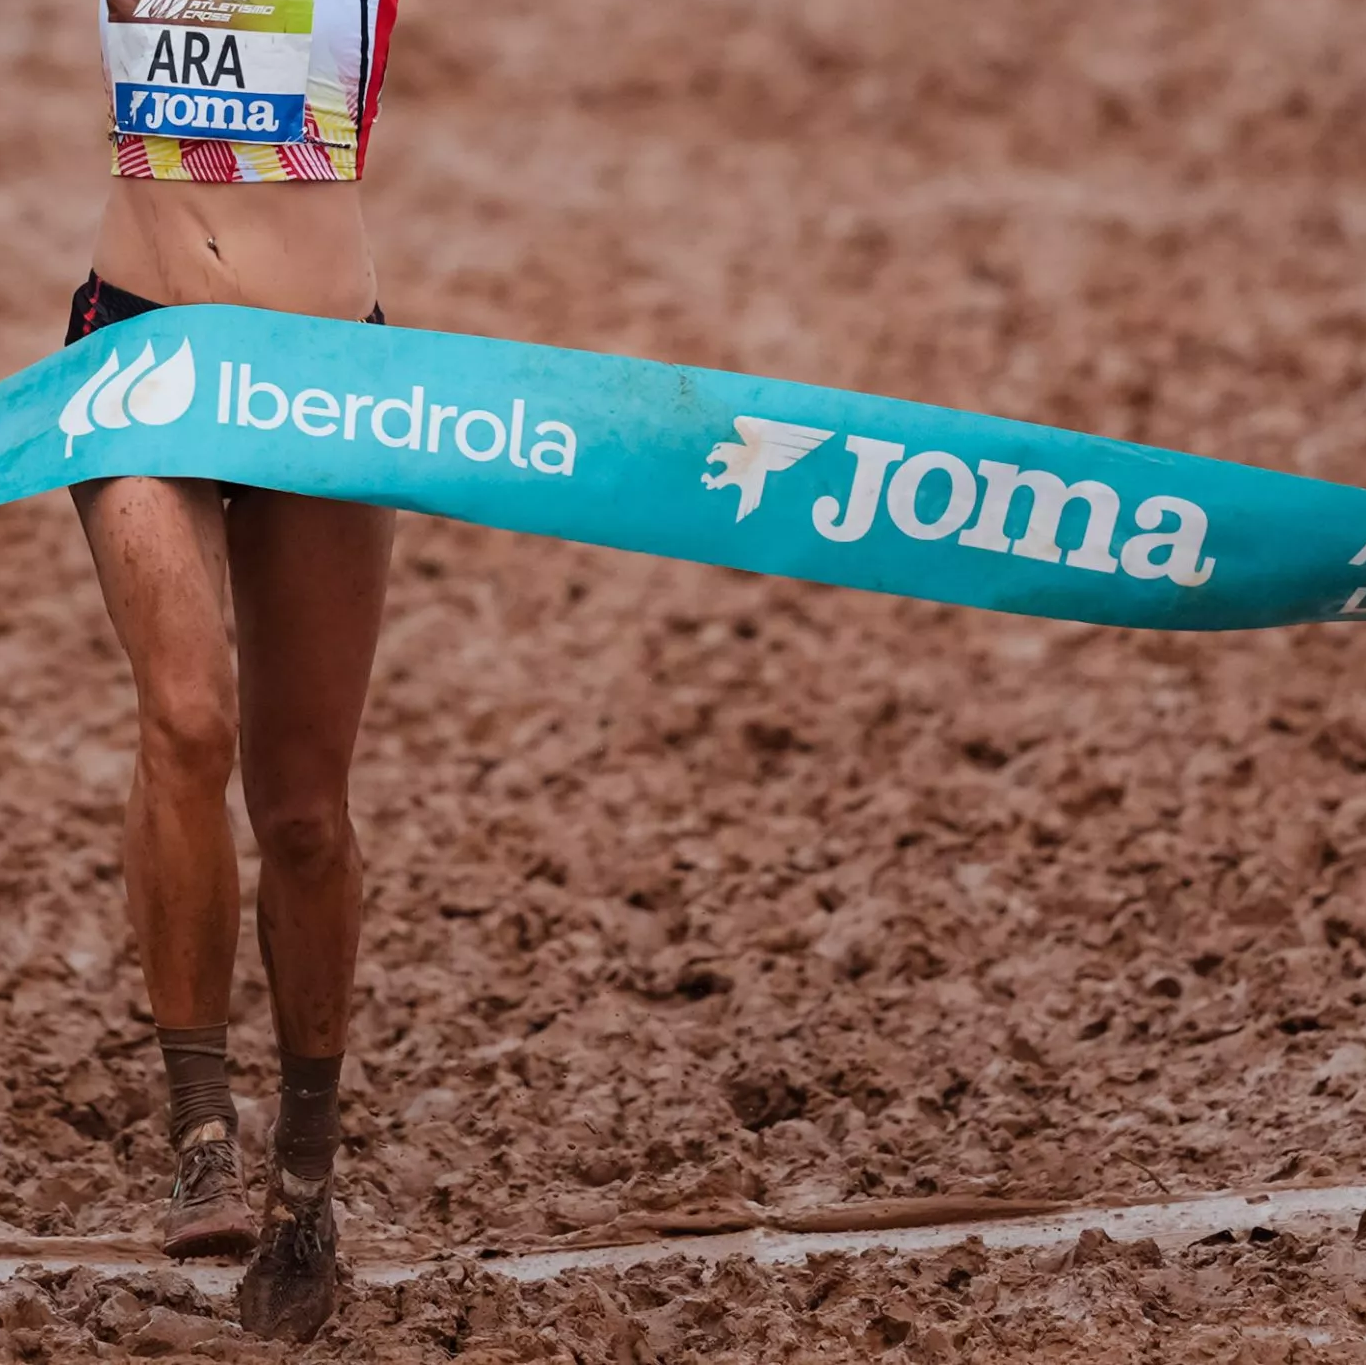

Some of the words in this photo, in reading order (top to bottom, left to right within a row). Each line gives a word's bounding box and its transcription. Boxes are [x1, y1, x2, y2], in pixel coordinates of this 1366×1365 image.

[181, 10, 233, 23] CROSS
[188, 0, 276, 16] ATLETISMO
[147, 29, 246, 89] ARA
[145, 91, 280, 132] Joma
[216, 360, 578, 477] Iberdrola
[811, 434, 1217, 588] Joma
